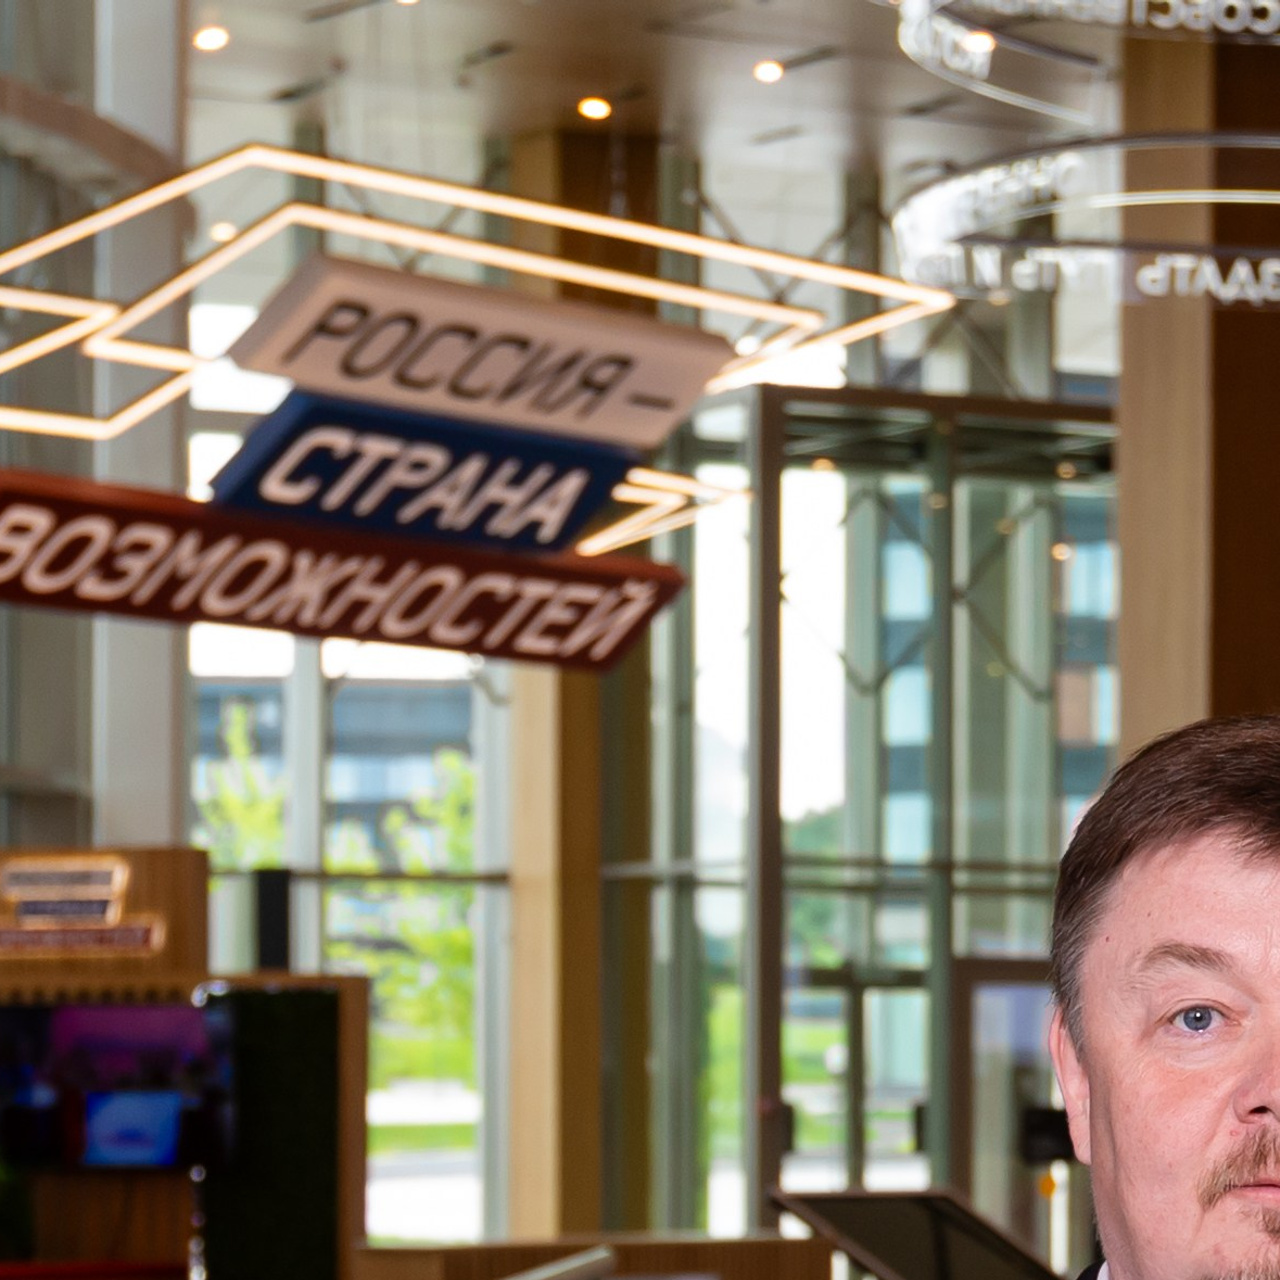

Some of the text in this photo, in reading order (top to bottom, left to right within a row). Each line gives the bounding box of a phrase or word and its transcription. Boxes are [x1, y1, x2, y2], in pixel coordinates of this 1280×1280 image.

[283, 300, 633, 422] РОССИЯ
[258, 426, 591, 545] СТРАНА
[0, 503, 659, 661] ВОЗМОЖНОСТЕЙ
